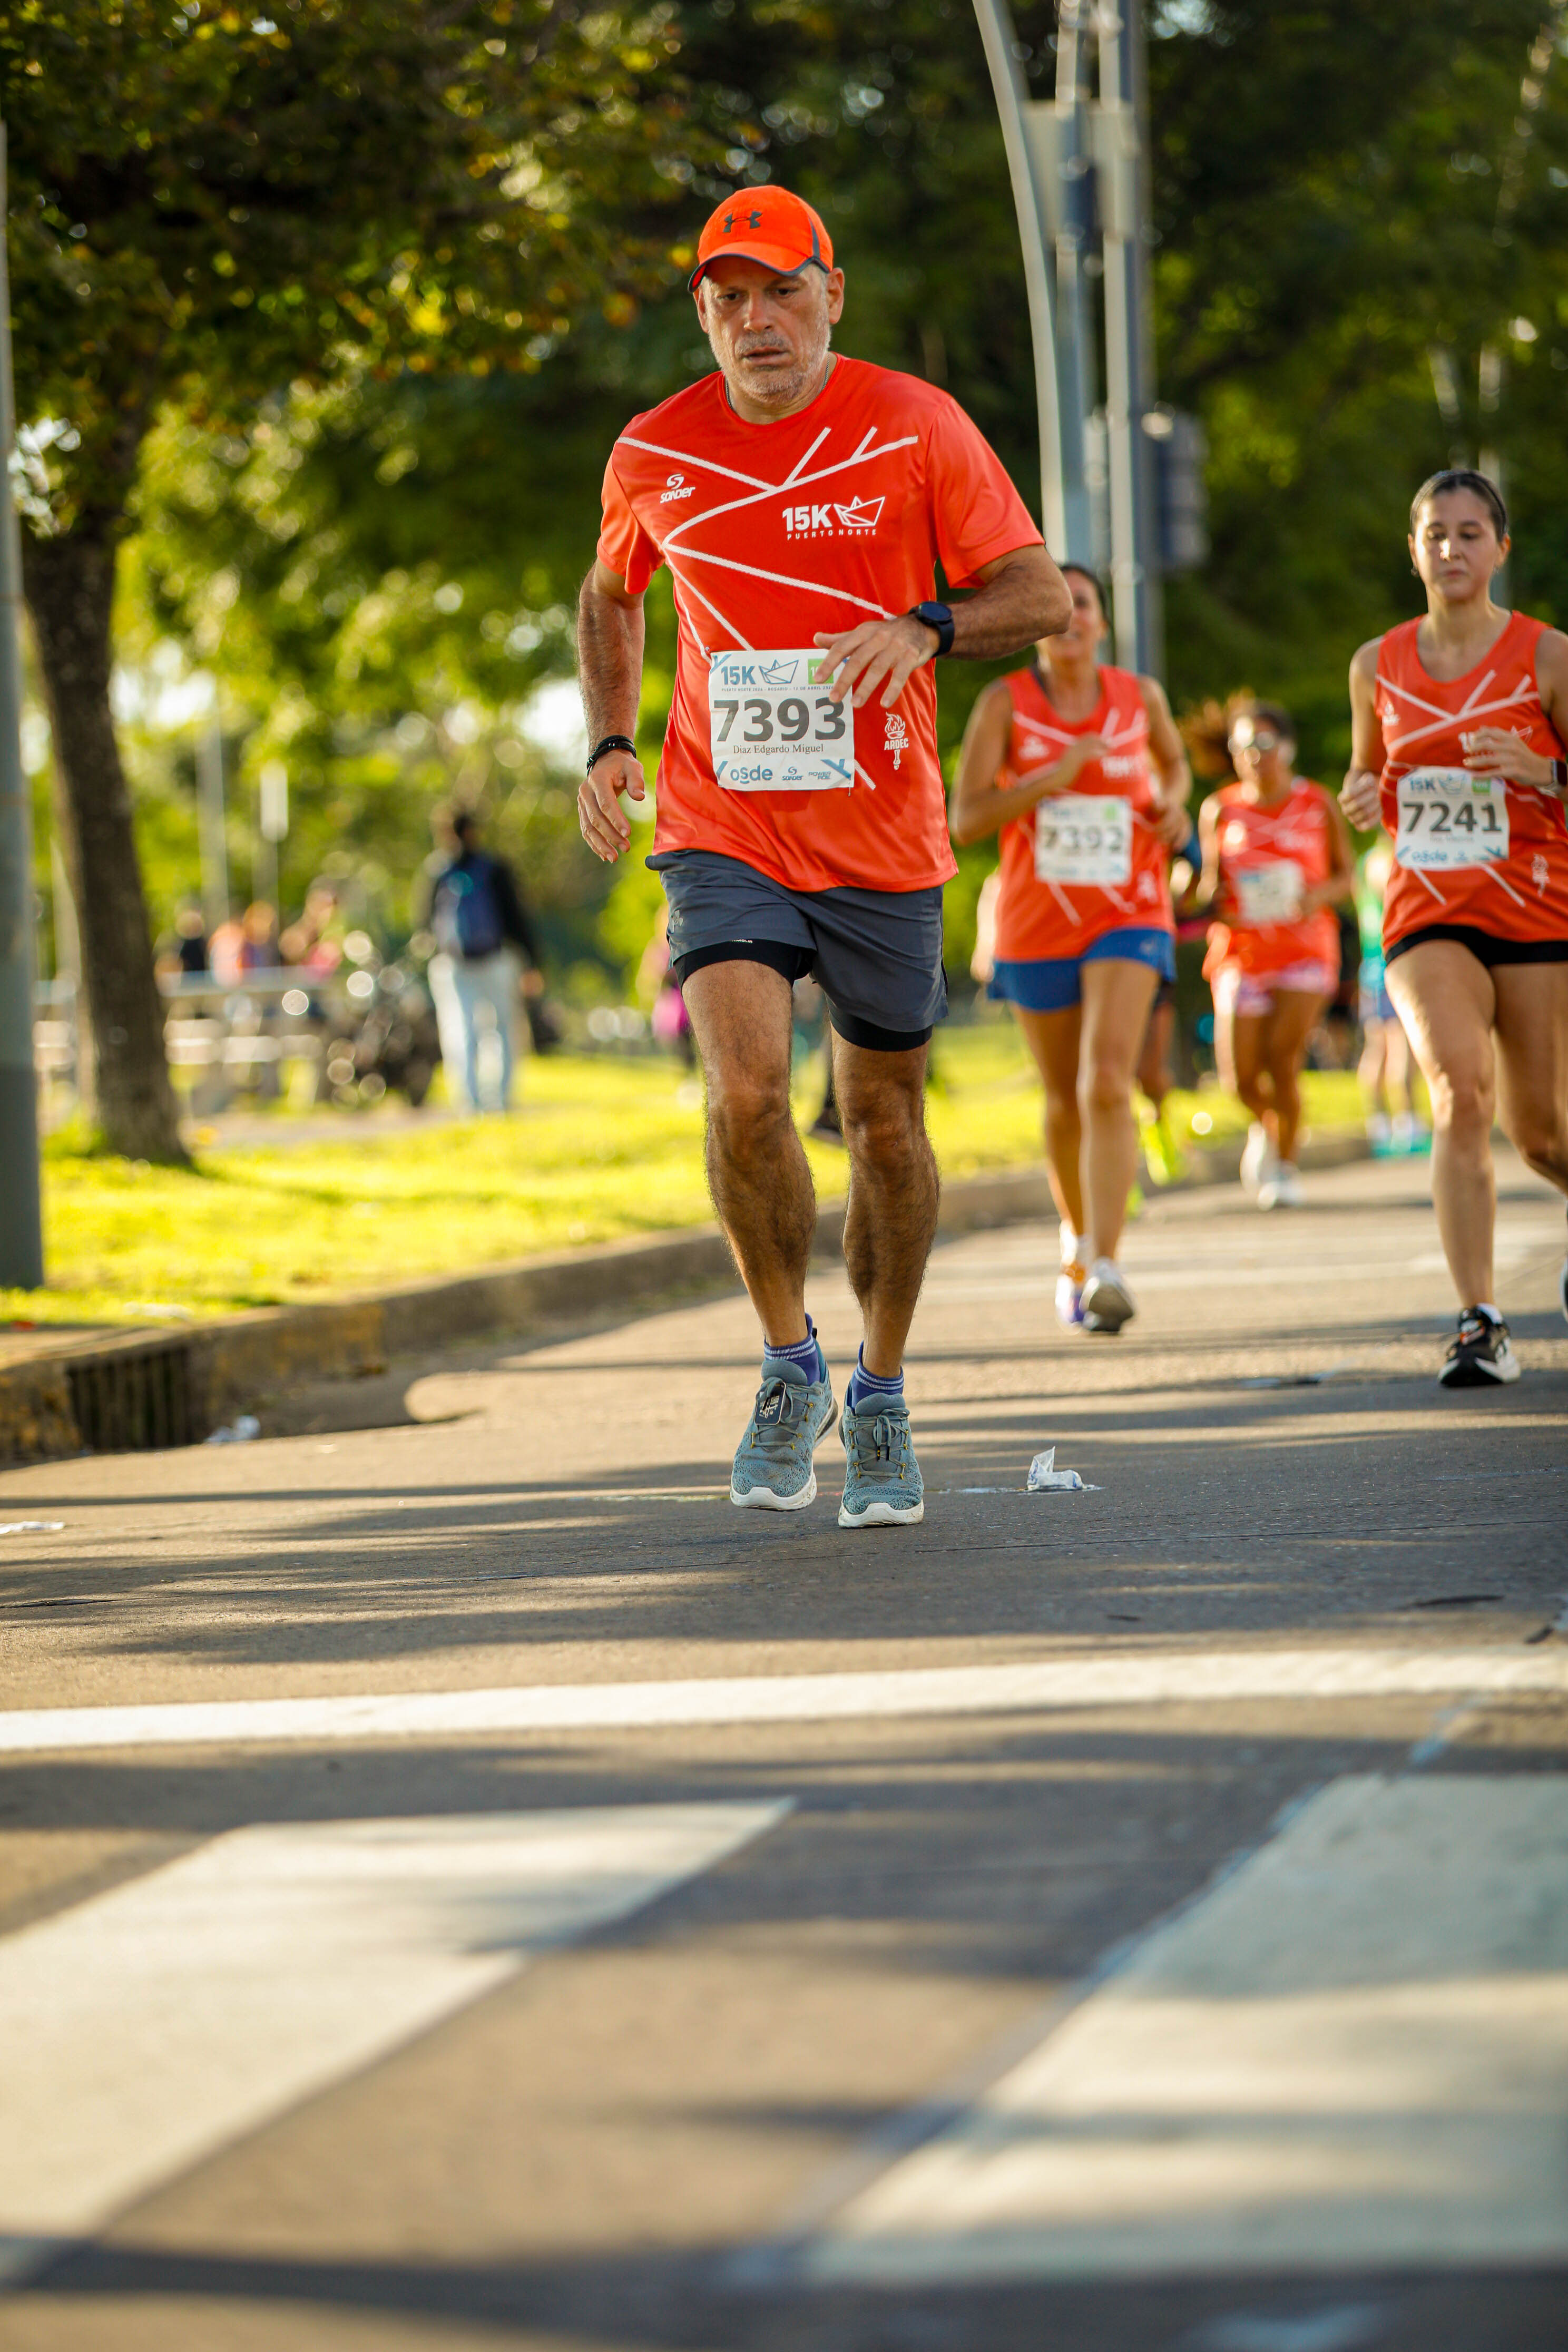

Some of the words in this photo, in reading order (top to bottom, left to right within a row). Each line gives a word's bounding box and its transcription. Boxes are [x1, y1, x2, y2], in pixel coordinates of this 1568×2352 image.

[782, 504, 832, 532] 15K
[787, 529, 833, 540] PUERTO
[721, 665, 756, 685] 15K
[714, 697, 846, 742] 7393
[733, 744, 751, 754] Diaz
[754, 744, 789, 755] Edgardo
[792, 743, 824, 754] Miguel
[884, 738, 909, 750] ARDEC
[730, 764, 773, 781] osde
[1403, 801, 1502, 832] 7241
[1041, 825, 1123, 854] 7392
